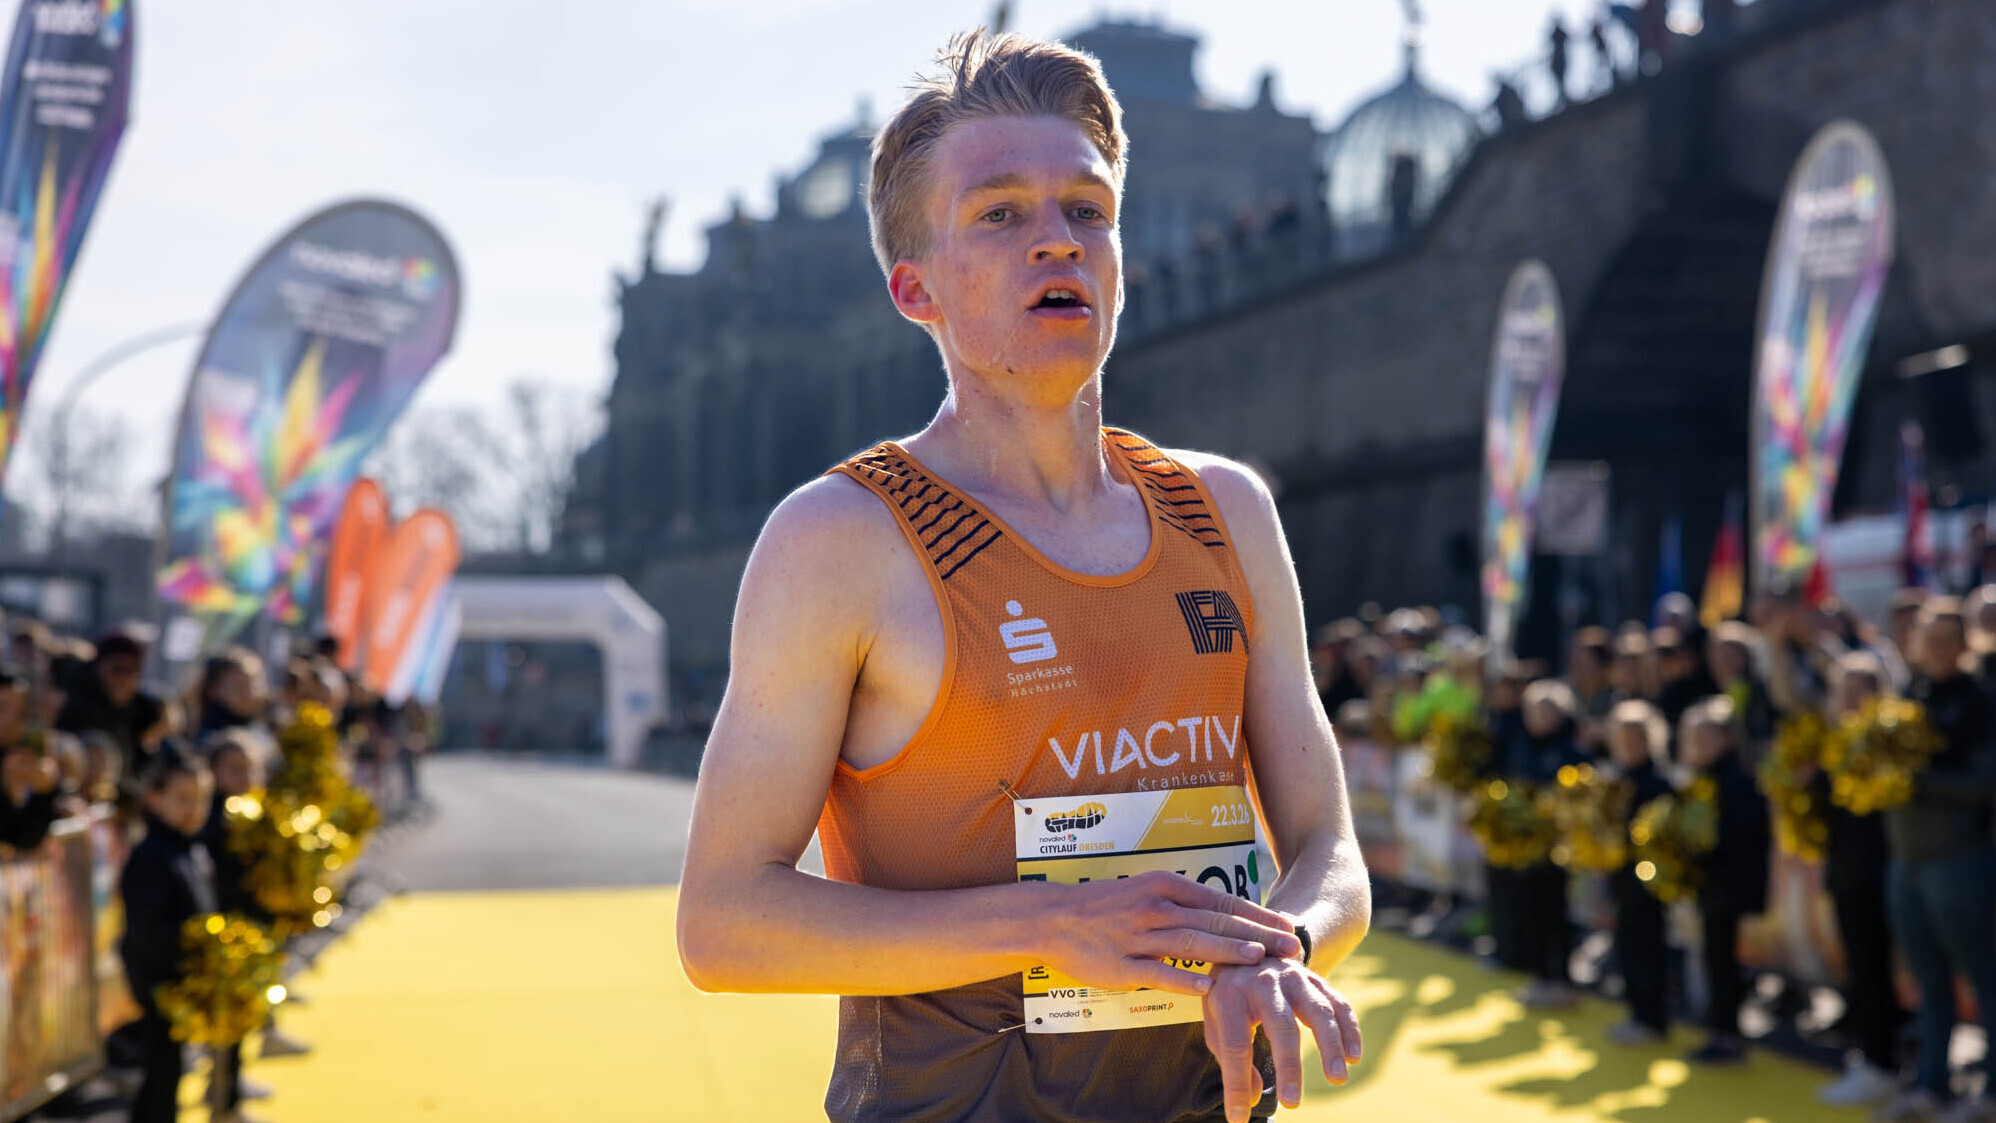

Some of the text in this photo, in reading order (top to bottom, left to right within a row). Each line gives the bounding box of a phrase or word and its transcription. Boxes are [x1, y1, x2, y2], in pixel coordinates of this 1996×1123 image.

[1007, 665, 1073, 685] Sparkasse
[1048, 715, 1240, 780] VIACTIV
[1210, 803, 1250, 828] 22.3.26
[1039, 835, 1066, 843] novaled
[1040, 841, 1115, 854] CITYLAUF DRESDEN
[1050, 989, 1076, 999] VVO
[1049, 1009, 1080, 1018] novaled
[1129, 1003, 1167, 1014] SAXOPRINT
